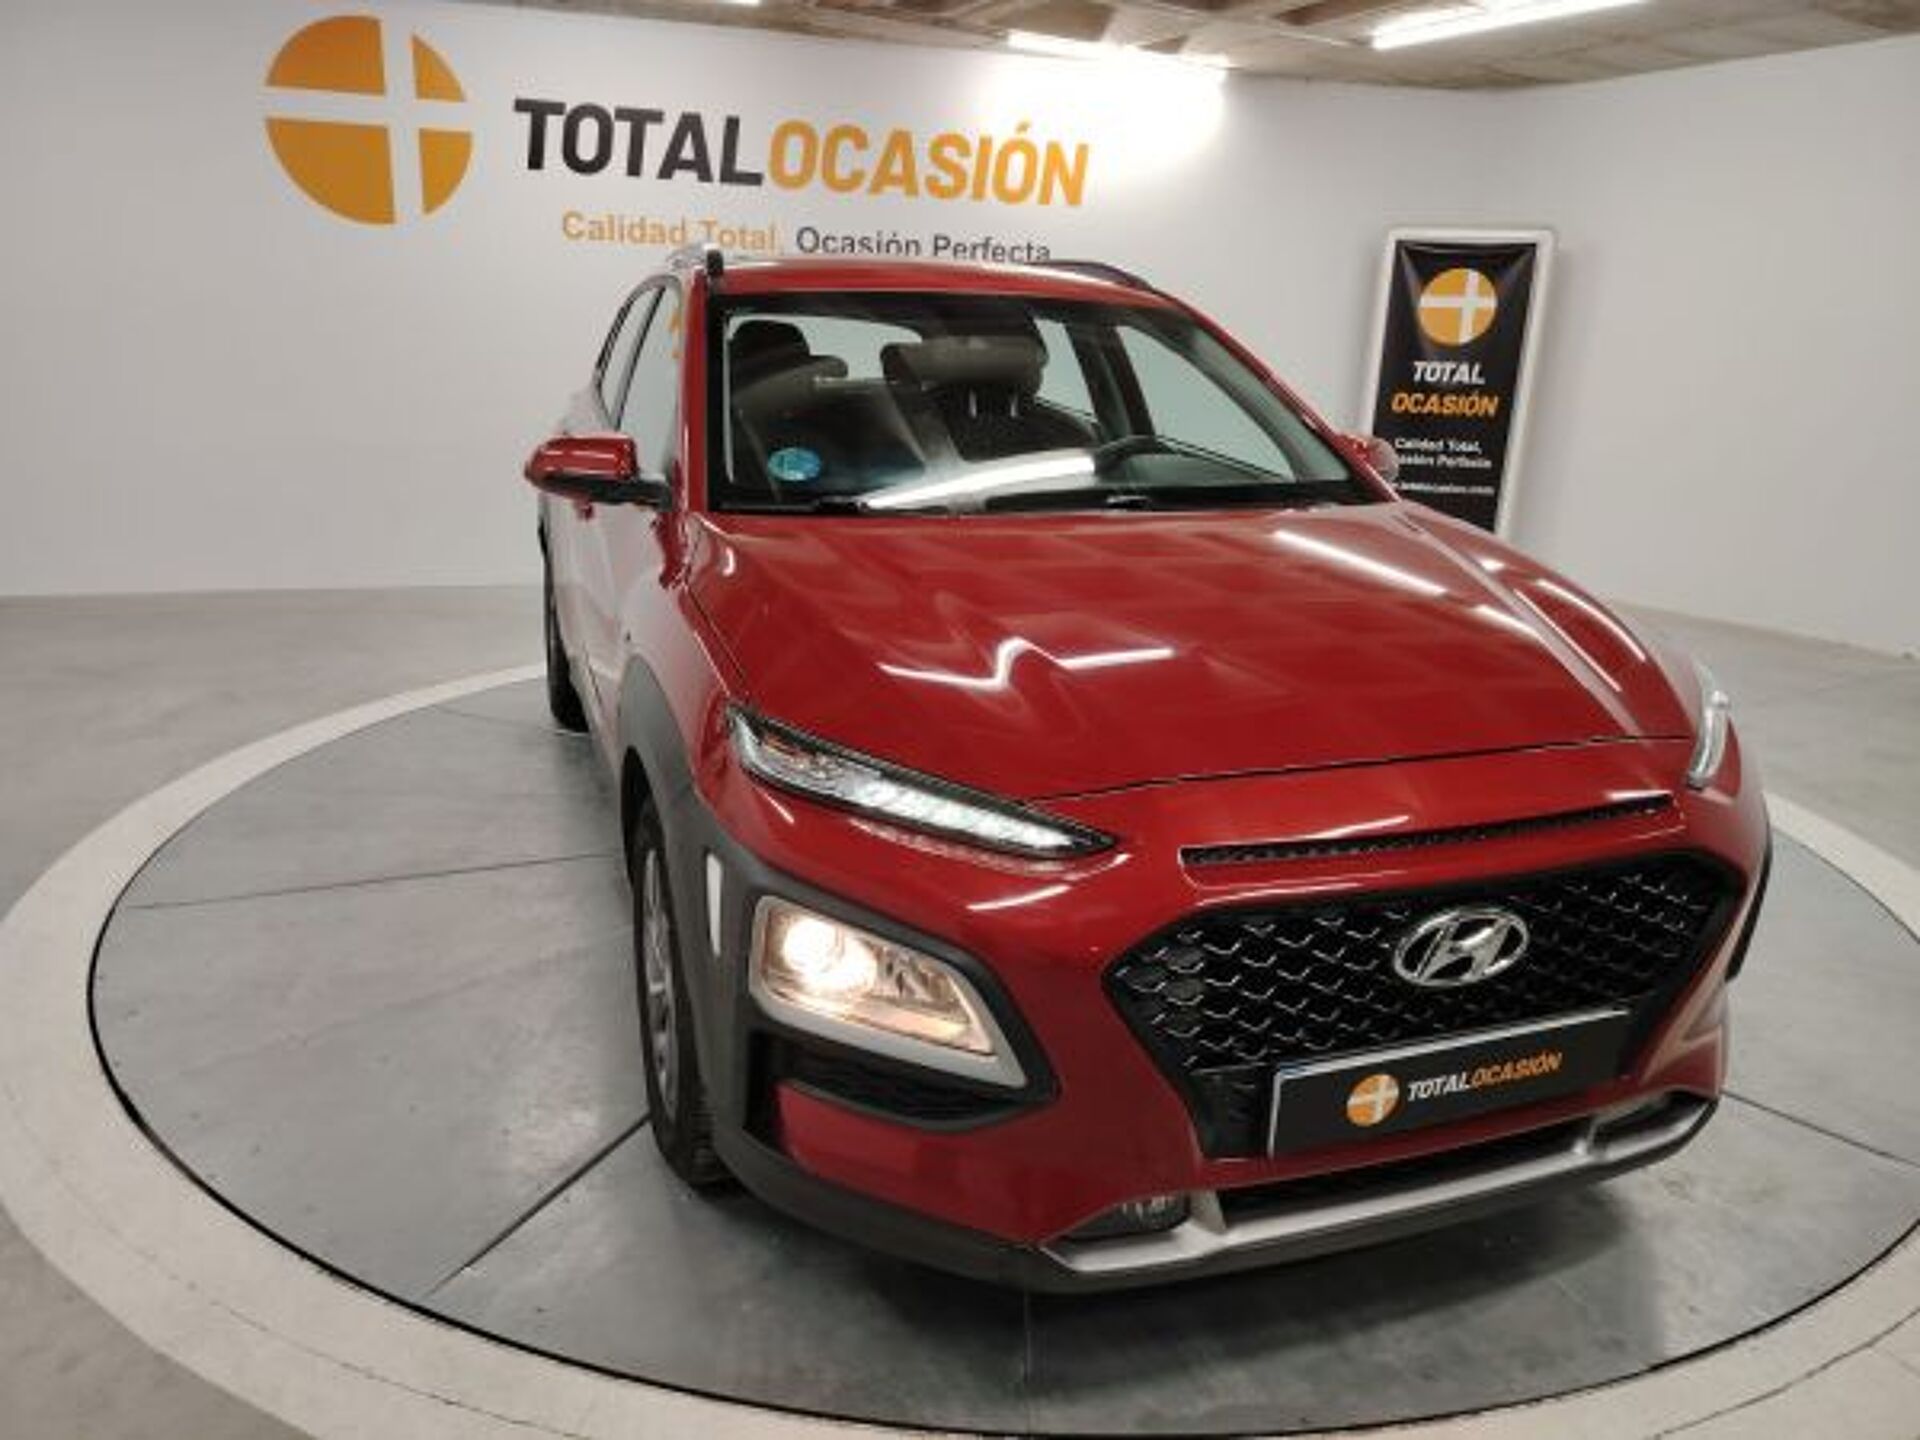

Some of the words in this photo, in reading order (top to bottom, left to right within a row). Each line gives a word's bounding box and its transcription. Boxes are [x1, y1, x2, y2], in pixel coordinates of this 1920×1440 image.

[562, 210, 686, 245] Calidad
[796, 226, 921, 256] Ocasión
[932, 233, 1051, 263] Perfecta
[1413, 361, 1486, 385] TOTAL
[1391, 390, 1499, 417] OCASIÓN
